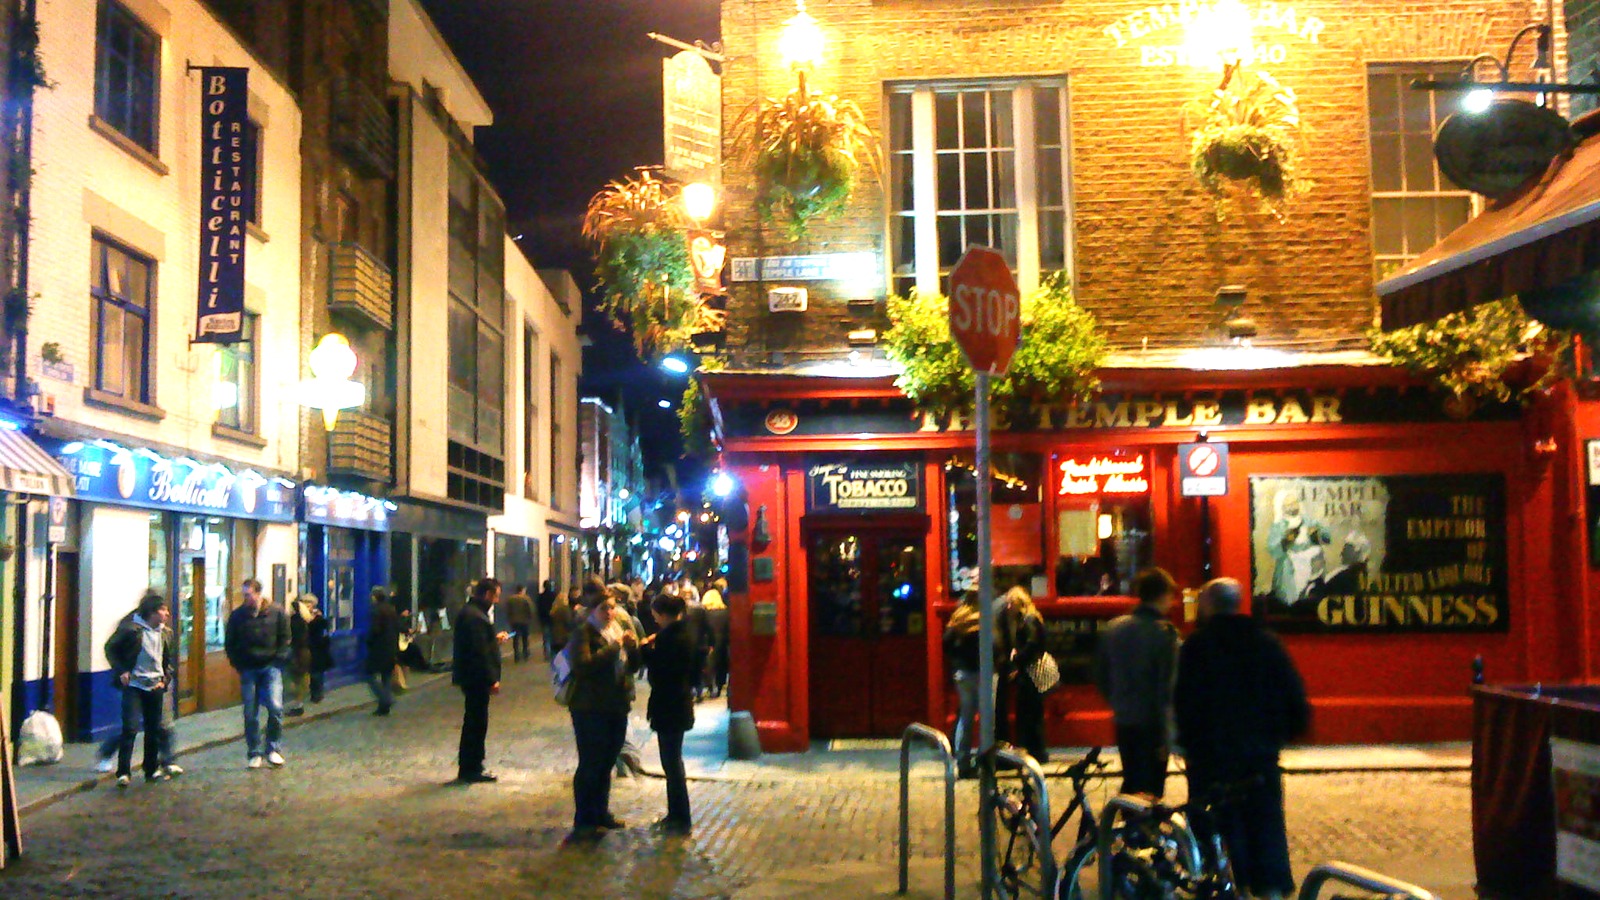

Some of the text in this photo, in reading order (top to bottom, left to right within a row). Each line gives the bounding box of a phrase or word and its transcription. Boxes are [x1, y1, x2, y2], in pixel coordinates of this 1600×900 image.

[208, 75, 226, 308] Botticelli
[229, 122, 241, 264] RESTAURANT
[955, 283, 1018, 338] STOP
[1030, 400, 1223, 429] TEMPLE
[1244, 396, 1342, 424] BAR
[822, 471, 908, 505] TOBACCO
[1316, 595, 1499, 627] GUINNESS
